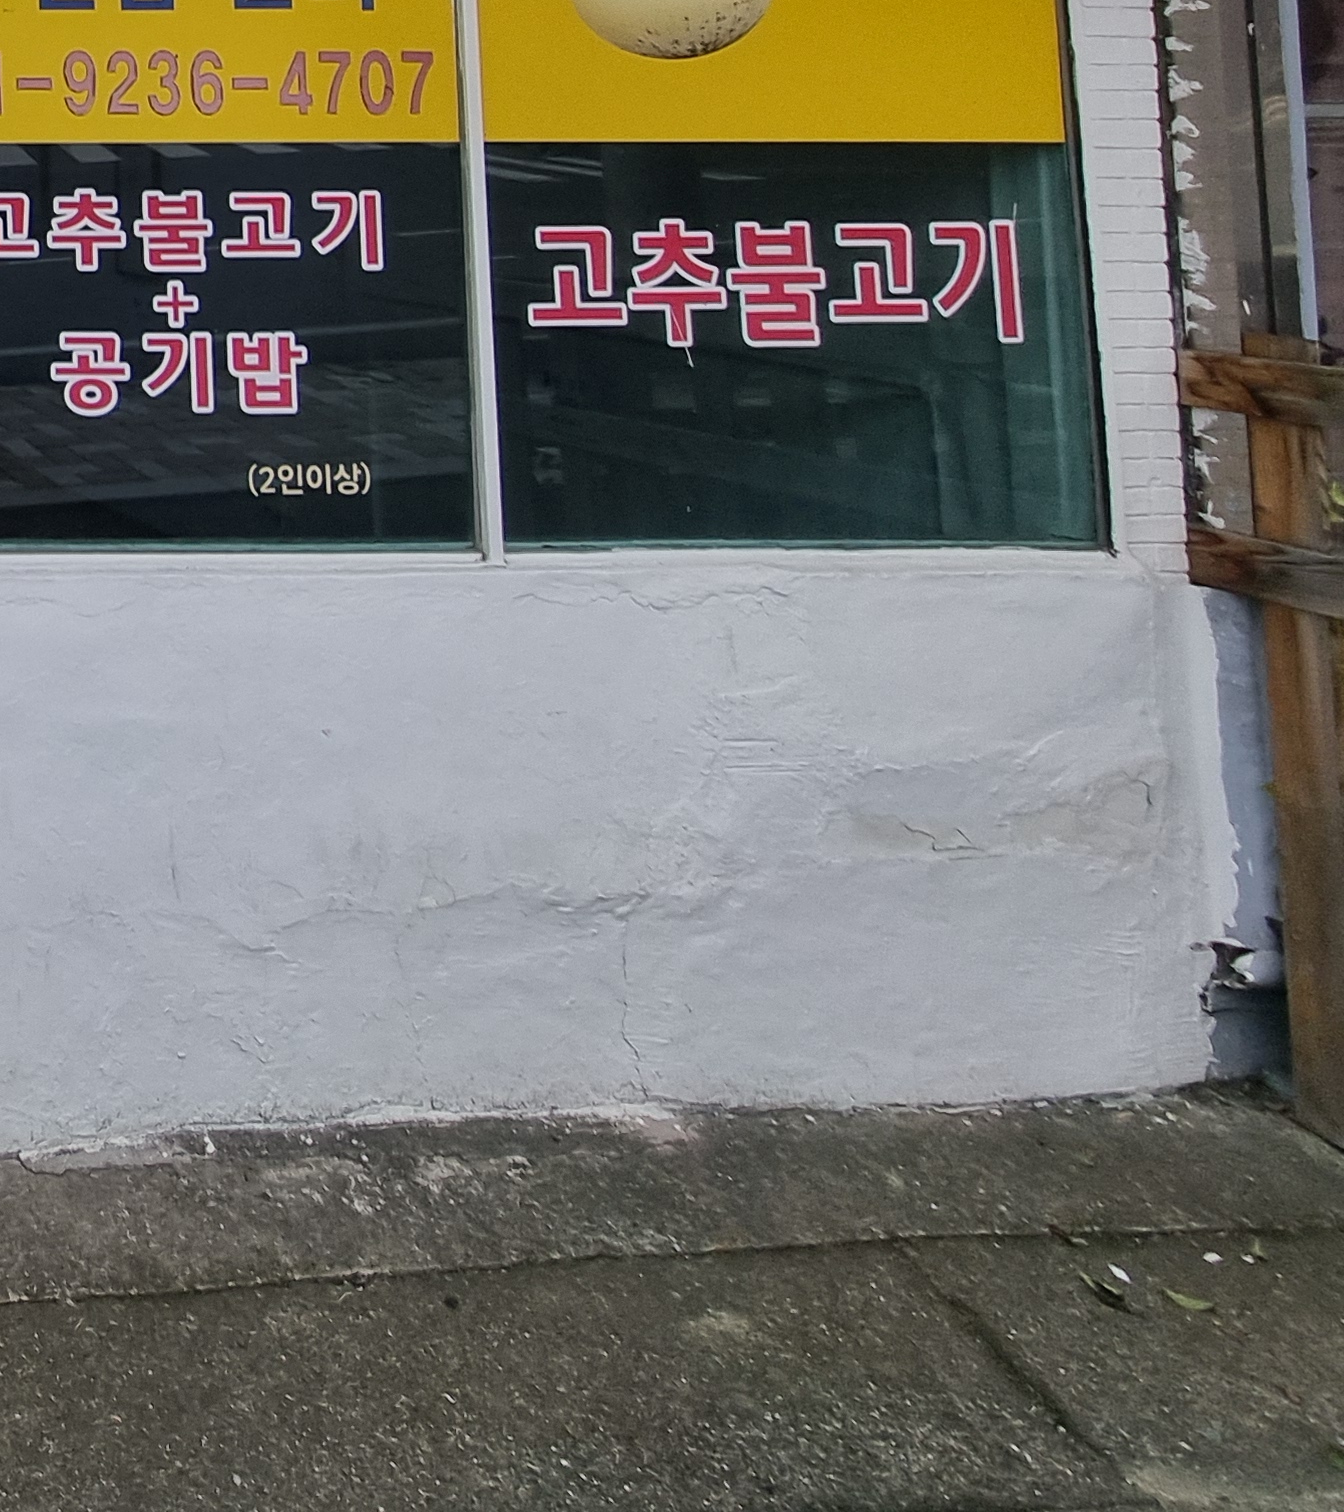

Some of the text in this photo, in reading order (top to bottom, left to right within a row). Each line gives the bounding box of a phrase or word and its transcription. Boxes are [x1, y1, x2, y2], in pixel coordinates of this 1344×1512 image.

[526, 217, 1026, 349] 고추불고기
[49, 331, 309, 418] 공기밥
[247, 461, 372, 497] (2인이상)
